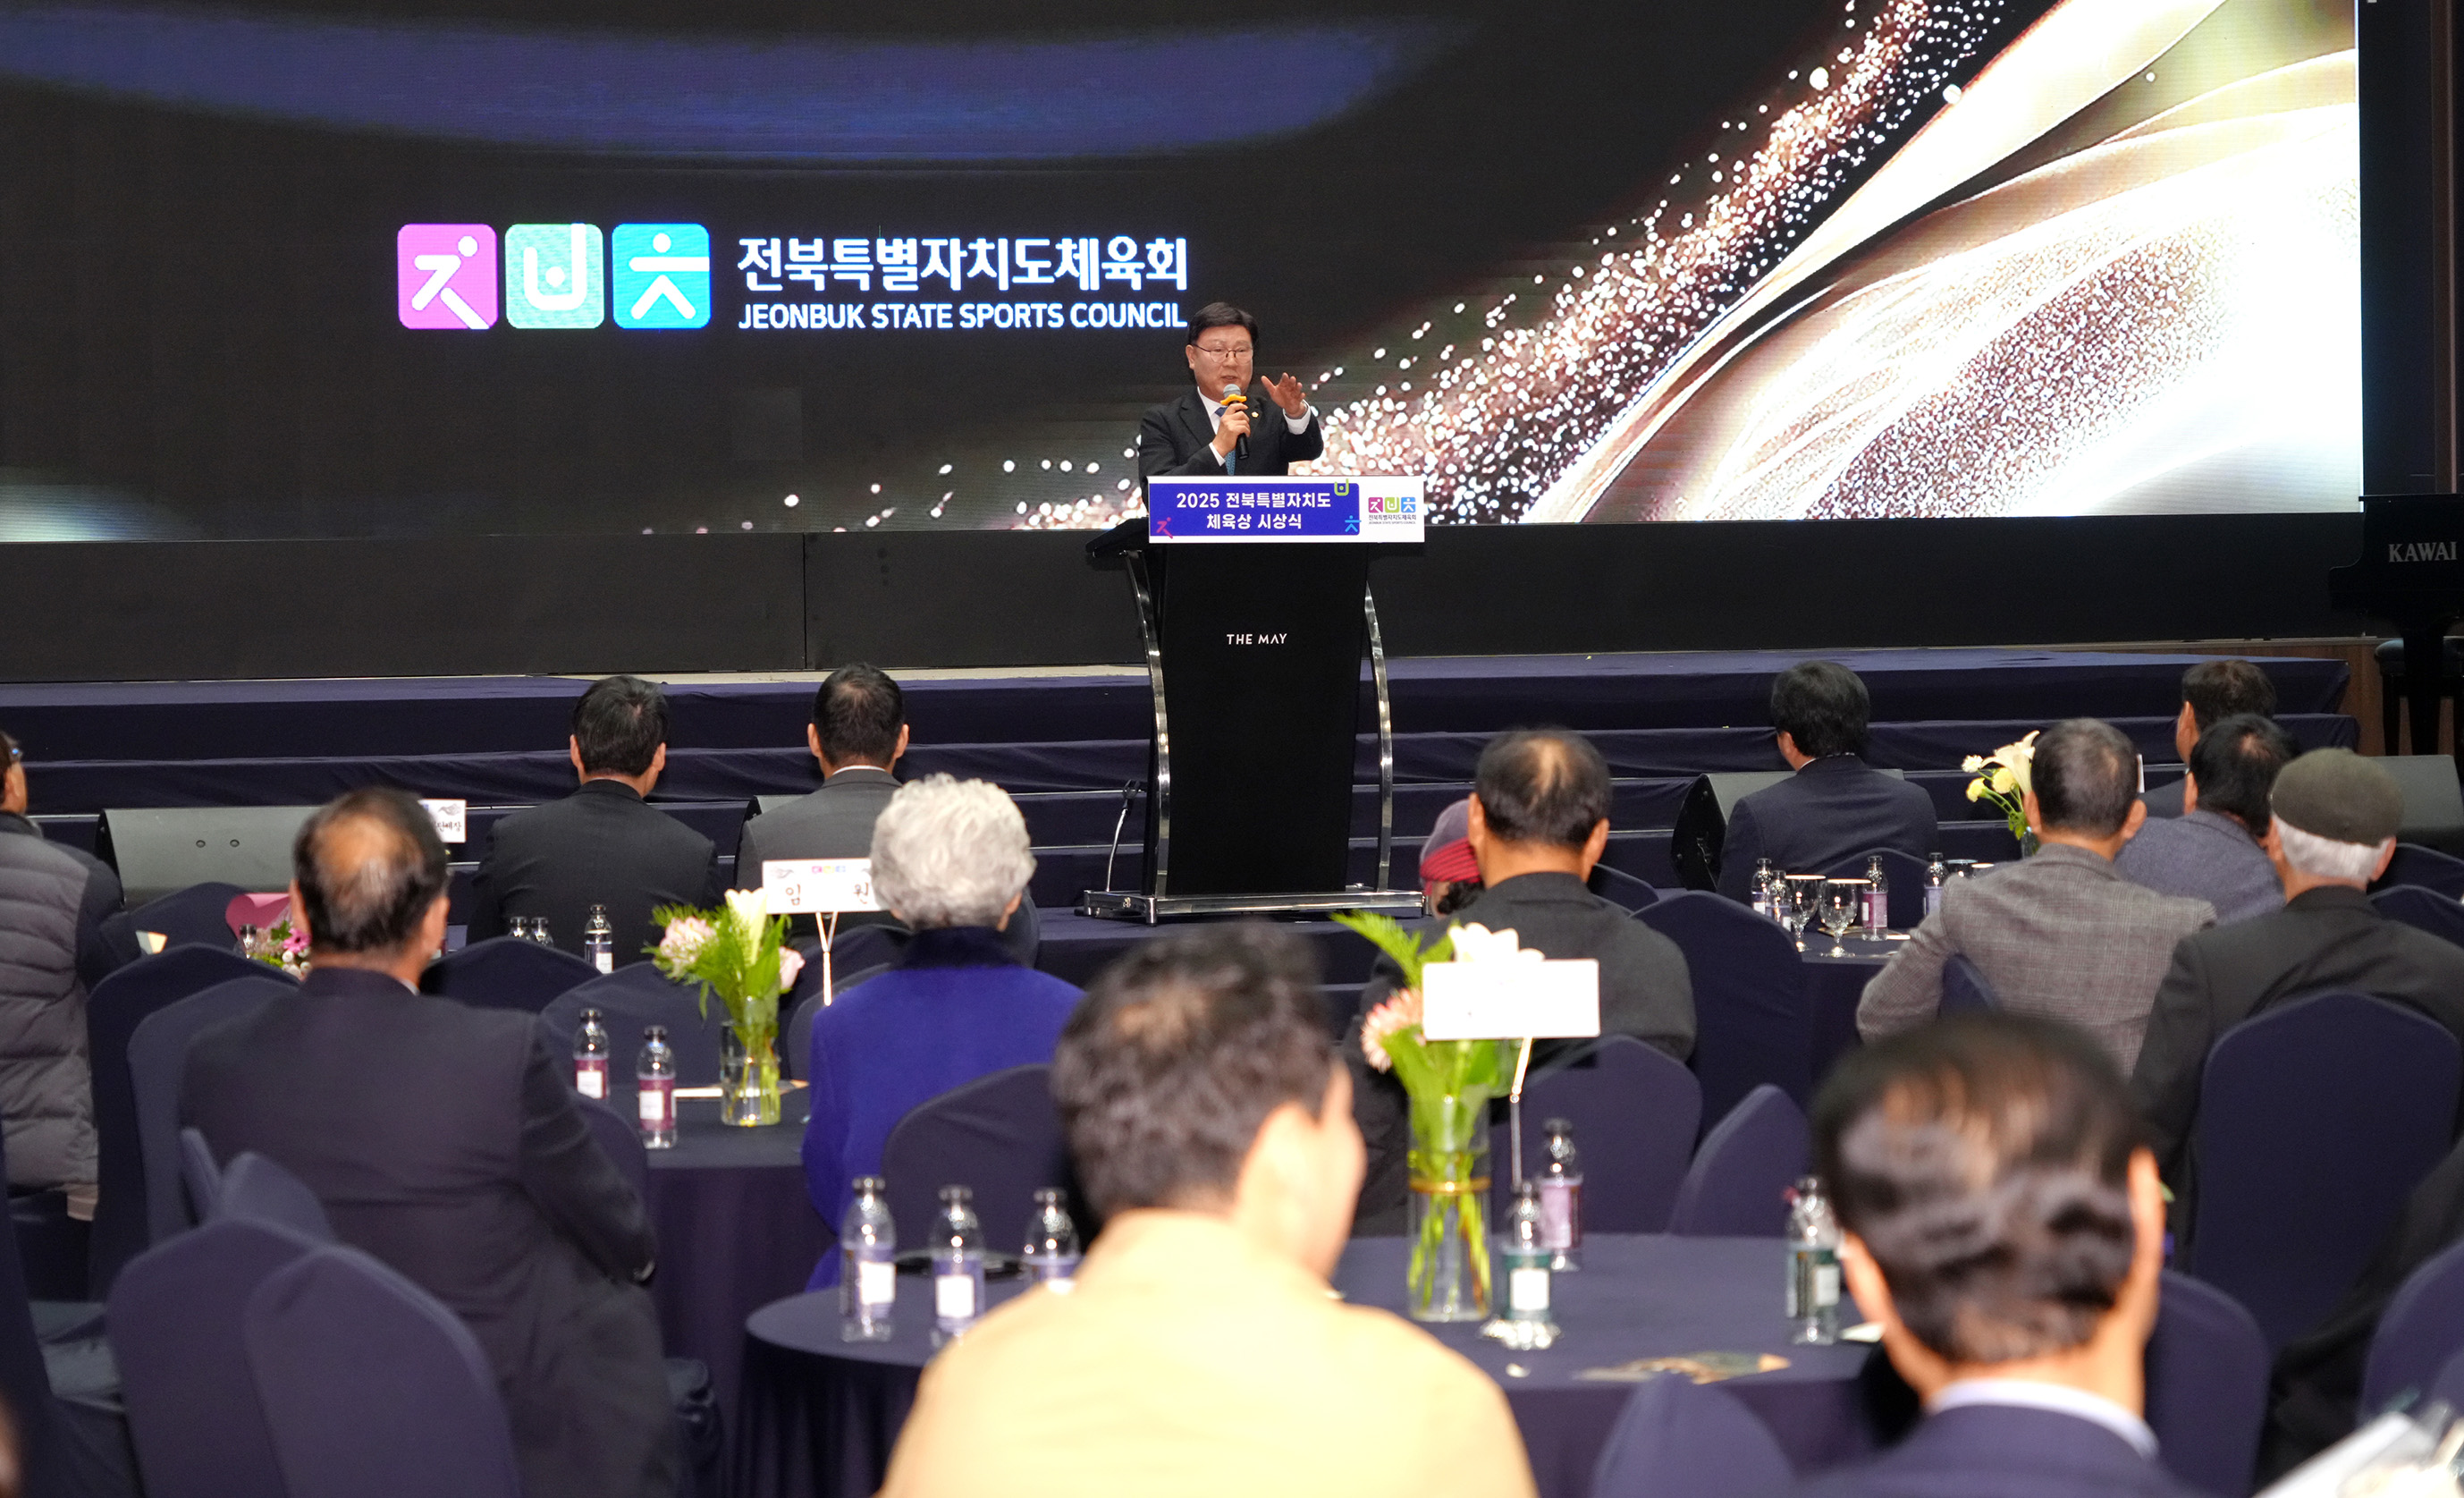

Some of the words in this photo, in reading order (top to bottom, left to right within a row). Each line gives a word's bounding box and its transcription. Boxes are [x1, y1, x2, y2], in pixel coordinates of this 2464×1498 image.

[737, 236, 1187, 292] 전북특별자치도체육회
[738, 303, 866, 329] JEONBUK
[871, 303, 954, 329] STATE
[958, 302, 1065, 329] SPORTS
[1069, 302, 1188, 328] COUNCIL
[1176, 492, 1220, 509] 2025
[1226, 492, 1331, 509] 전북특별자치도
[1206, 513, 1253, 529] 체육상
[1257, 513, 1302, 529] 시상식
[2389, 541, 2457, 563] KAWAI
[1227, 633, 1253, 645] THE
[1258, 633, 1287, 645] MAY
